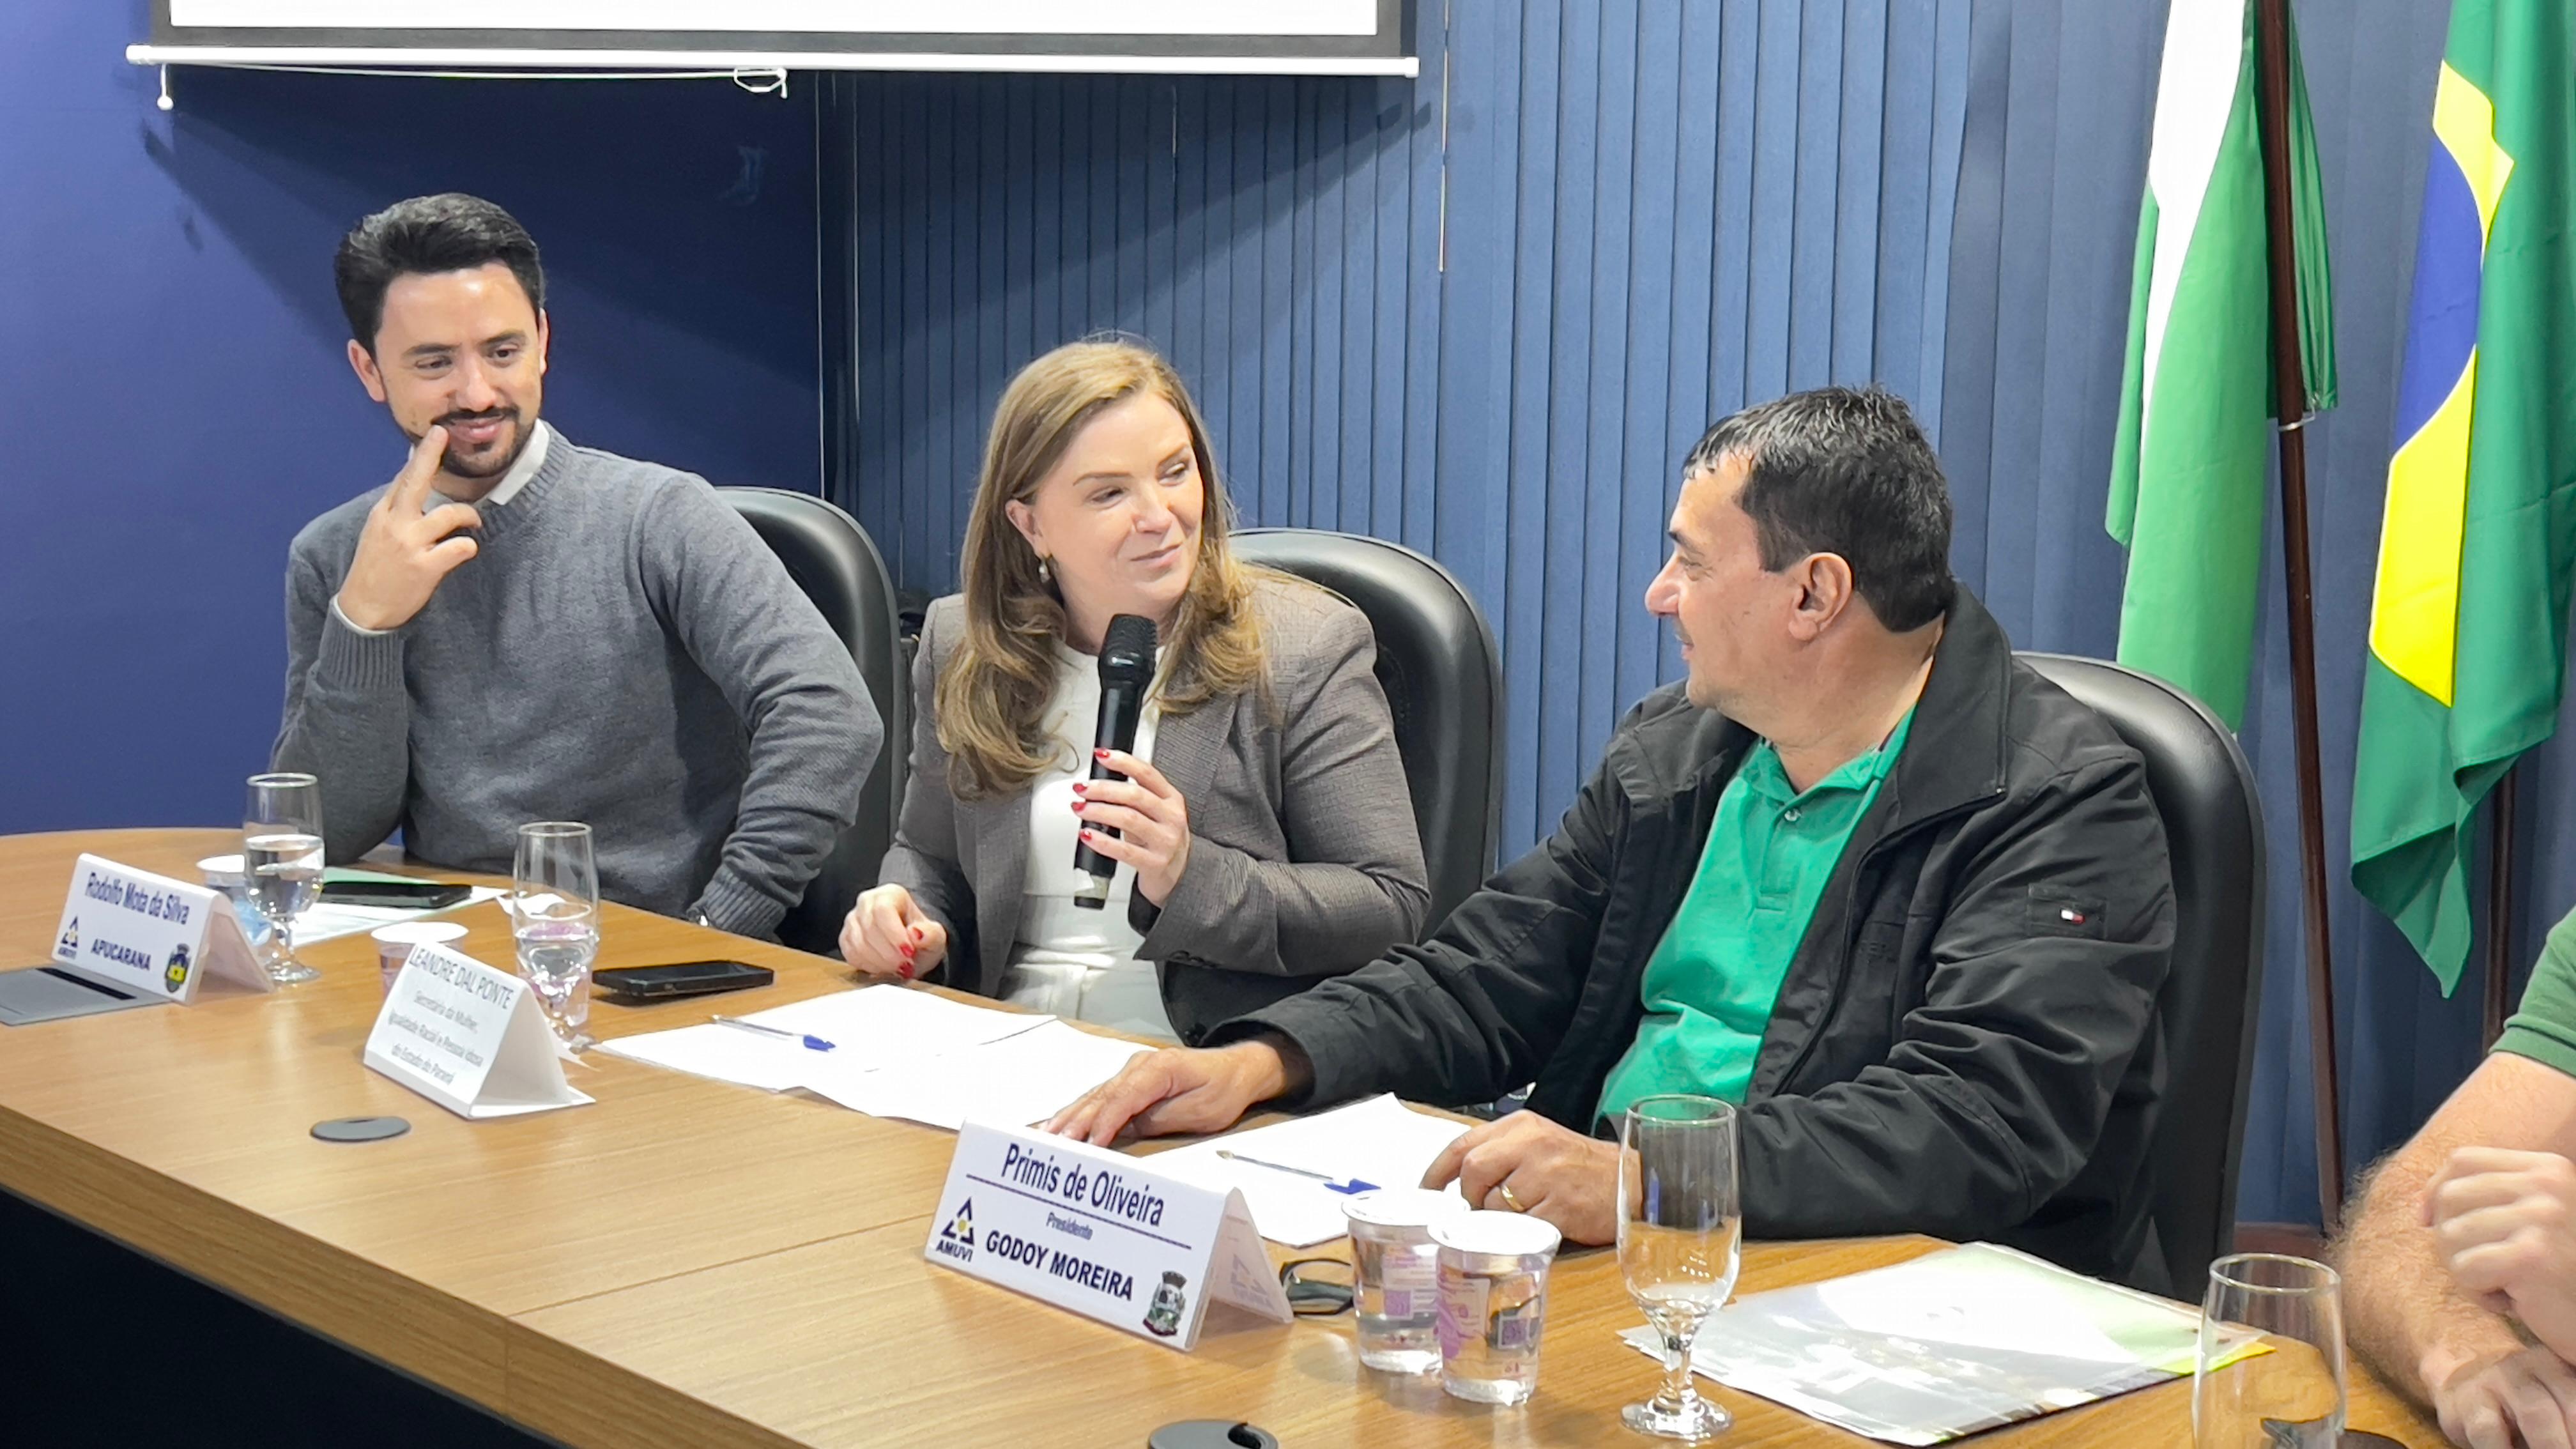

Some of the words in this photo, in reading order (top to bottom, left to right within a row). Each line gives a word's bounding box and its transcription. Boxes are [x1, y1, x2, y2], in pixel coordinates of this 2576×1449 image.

[148, 890, 163, 917] da
[91, 939, 151, 971] APUCARANA
[409, 947, 457, 983] LEANDRE
[454, 966, 476, 993] DAL
[477, 976, 514, 1009] PONTE
[1000, 1143, 1061, 1195] Primis
[1062, 1163, 1087, 1202] de
[1091, 1170, 1165, 1227] Oliveira
[936, 1240, 974, 1262] AMUVI
[985, 1230, 1050, 1270] GODOY
[1049, 1251, 1134, 1301] MOREIRA
